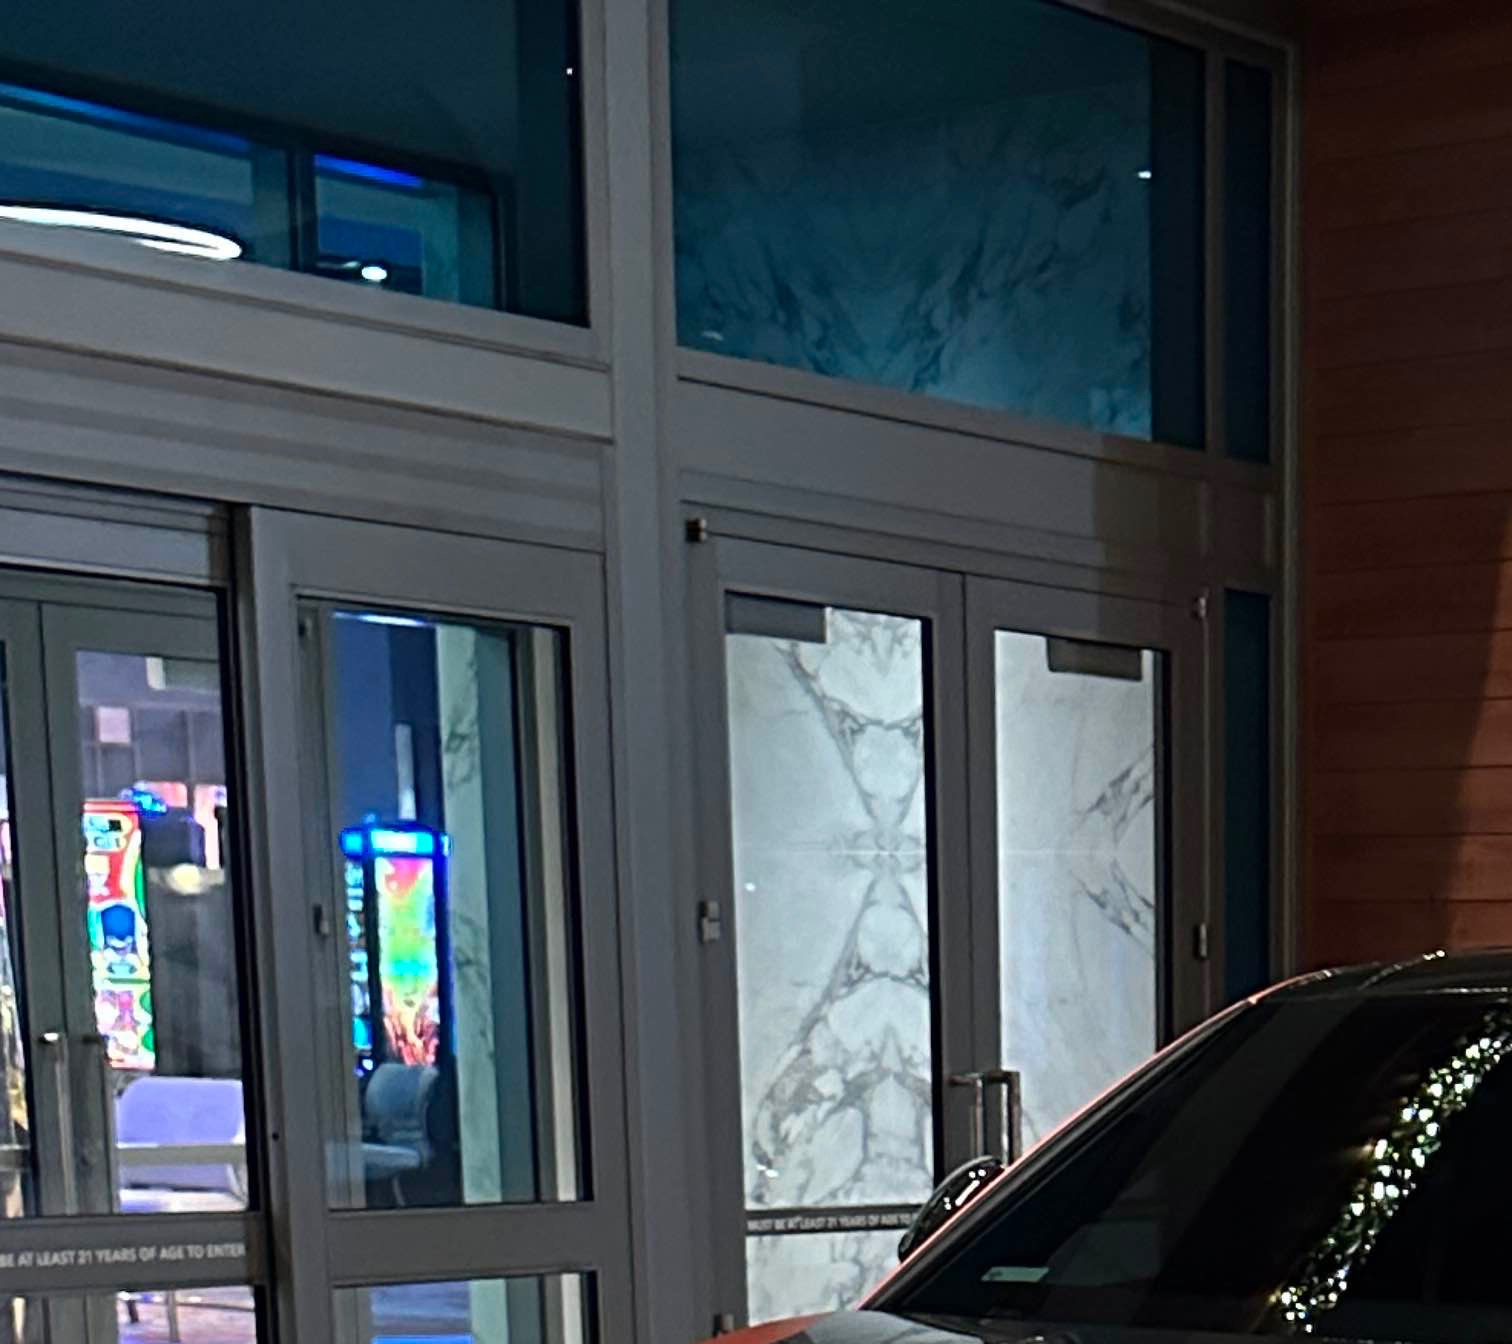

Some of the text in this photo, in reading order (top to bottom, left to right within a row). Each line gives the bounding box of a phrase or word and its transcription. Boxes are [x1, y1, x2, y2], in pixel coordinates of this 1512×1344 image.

[18, 1250, 34, 1267] AT
[36, 1249, 76, 1267] LEAST
[77, 1248, 93, 1266] 21
[95, 1246, 137, 1264] YEARS
[138, 1245, 156, 1262] OF
[160, 1244, 184, 1260] AGE
[186, 1243, 204, 1259] TO
[206, 1242, 245, 1258] ENTER
